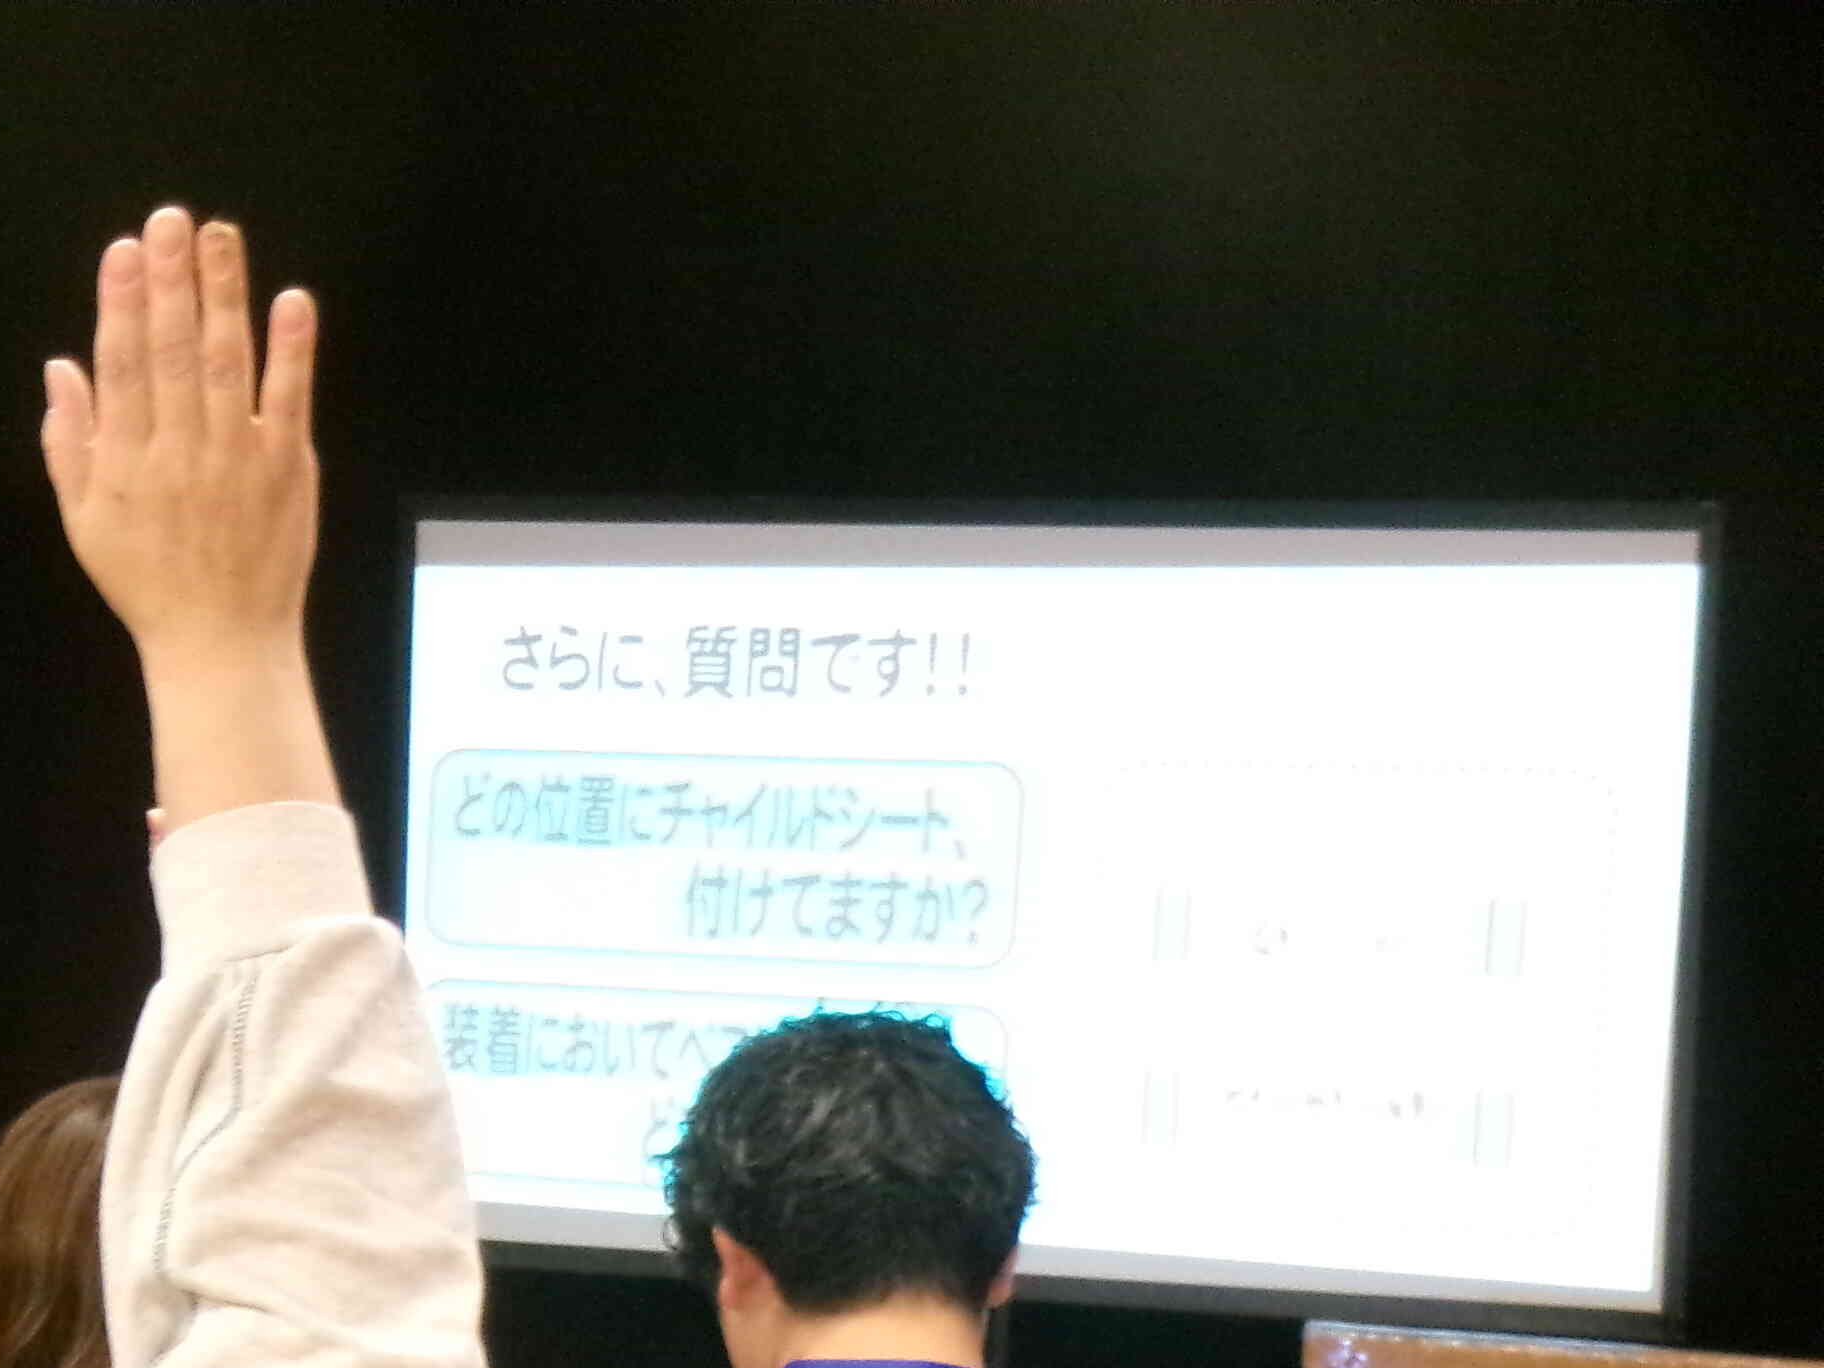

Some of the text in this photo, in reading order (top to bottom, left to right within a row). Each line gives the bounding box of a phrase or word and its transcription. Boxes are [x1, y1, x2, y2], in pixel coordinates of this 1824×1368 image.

[453, 772, 967, 860] どの位置にチャイルドシート、
[686, 860, 991, 944] 付けてますか?
